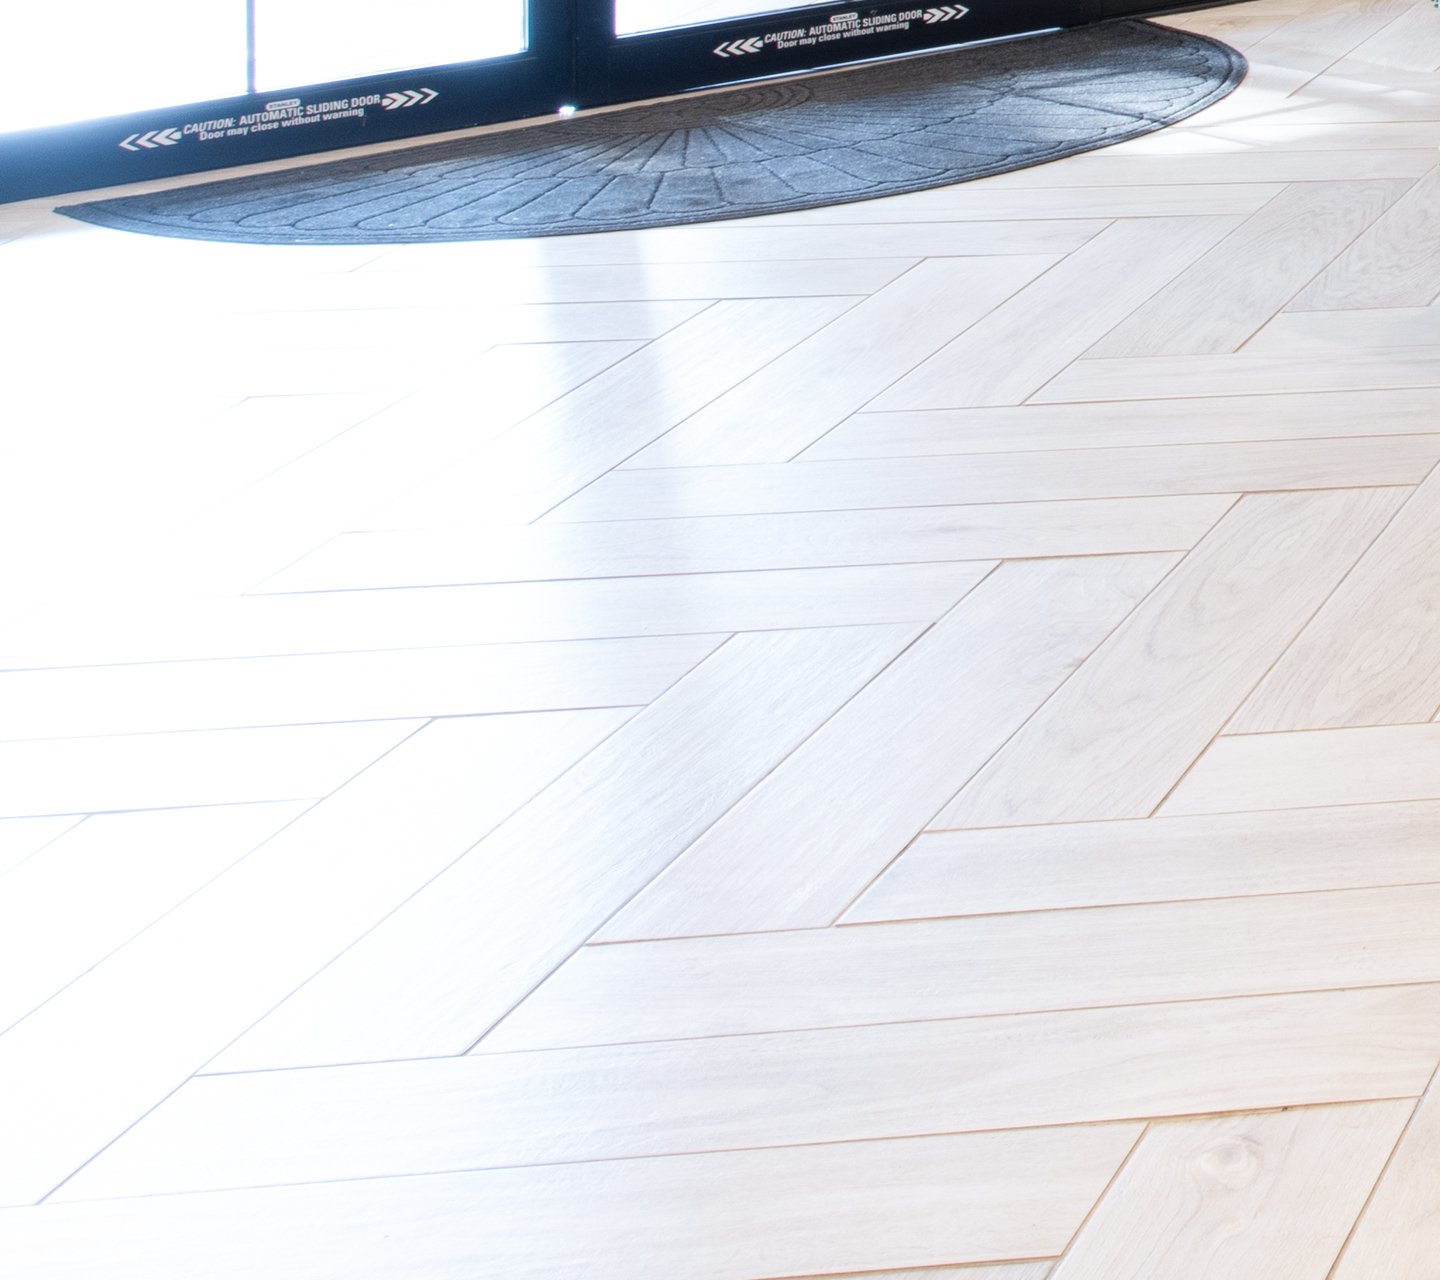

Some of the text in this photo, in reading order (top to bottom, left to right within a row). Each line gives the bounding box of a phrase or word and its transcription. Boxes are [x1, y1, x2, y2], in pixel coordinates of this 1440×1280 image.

[764, 9, 922, 43] CAUTION: AUTOMATIC SLIDING DOOR
[777, 21, 910, 49] Door may close without warning
[183, 94, 381, 135] CAUTION: AUTOMATIC SLIDING DOOR
[199, 107, 364, 141] Door may close without warning
